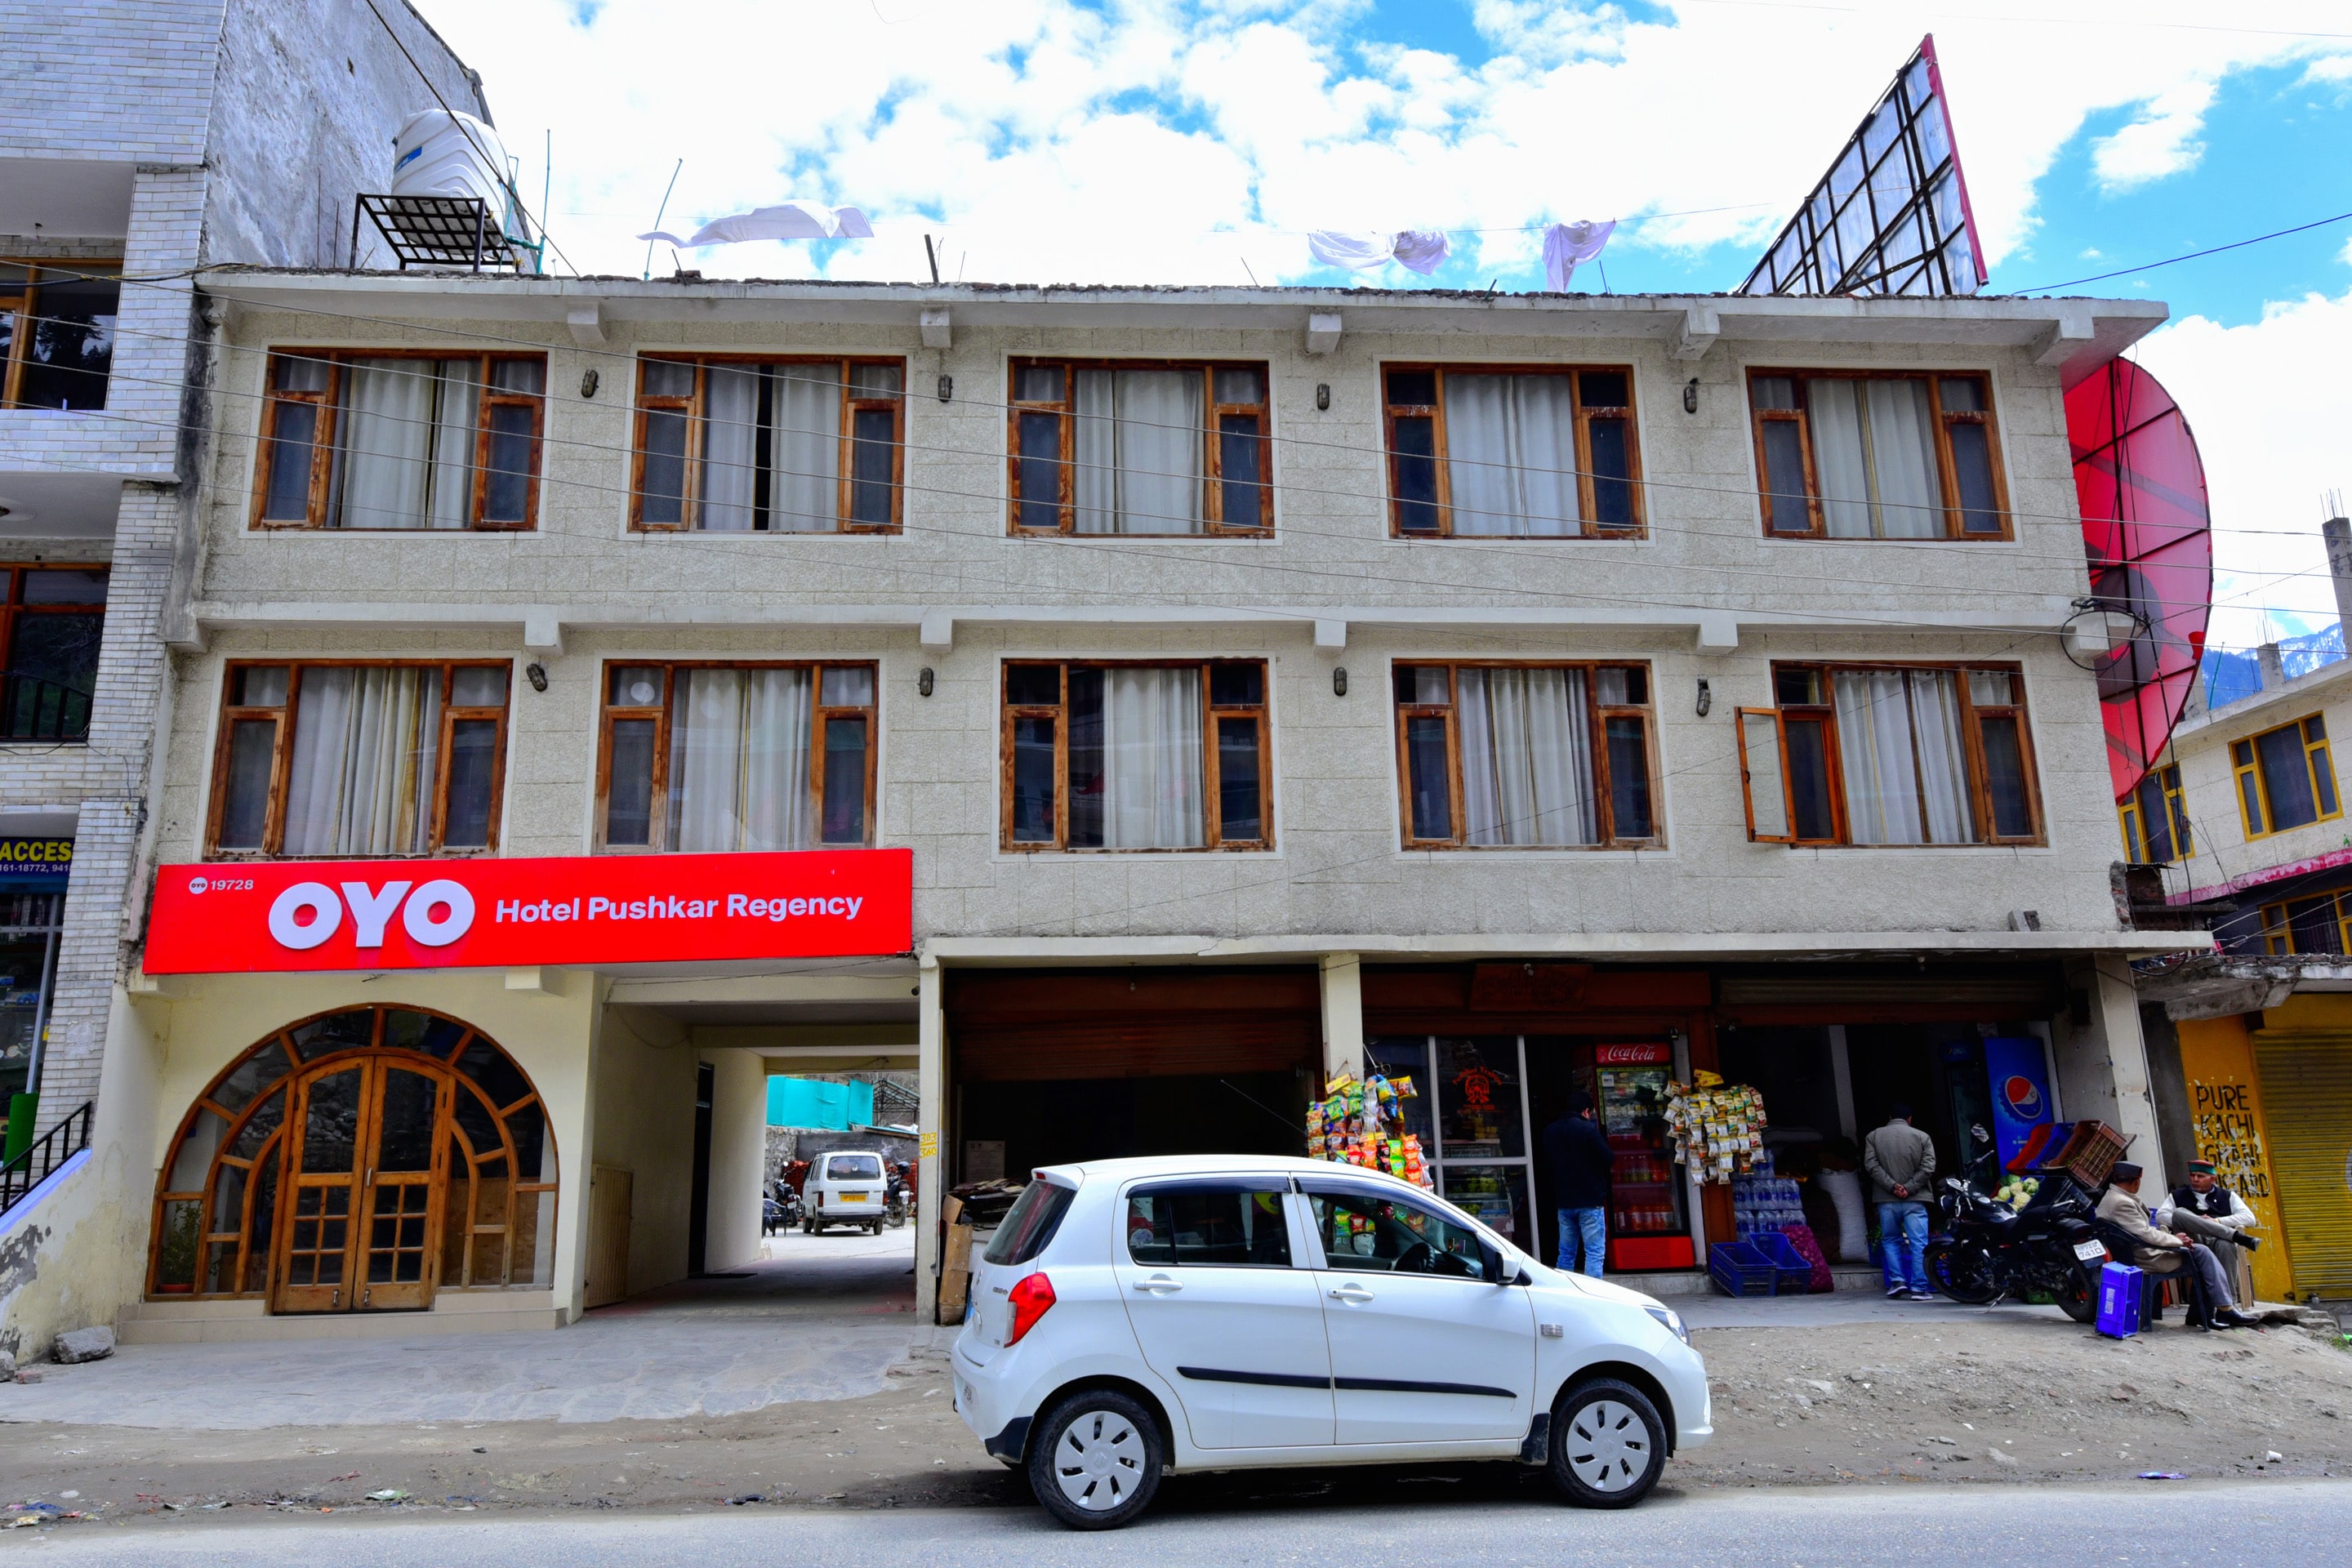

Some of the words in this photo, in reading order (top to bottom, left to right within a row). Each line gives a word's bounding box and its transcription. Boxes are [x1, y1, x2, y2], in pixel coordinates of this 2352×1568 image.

[51, 864, 71, 872] 941
[211, 879, 254, 891] 19728
[268, 879, 475, 950] OYO
[496, 898, 580, 923] Hotel
[587, 895, 719, 920] Pushkar
[727, 893, 863, 922] Regency
[2195, 1085, 2250, 1111] PURE
[2200, 1113, 2256, 1140] KACHI
